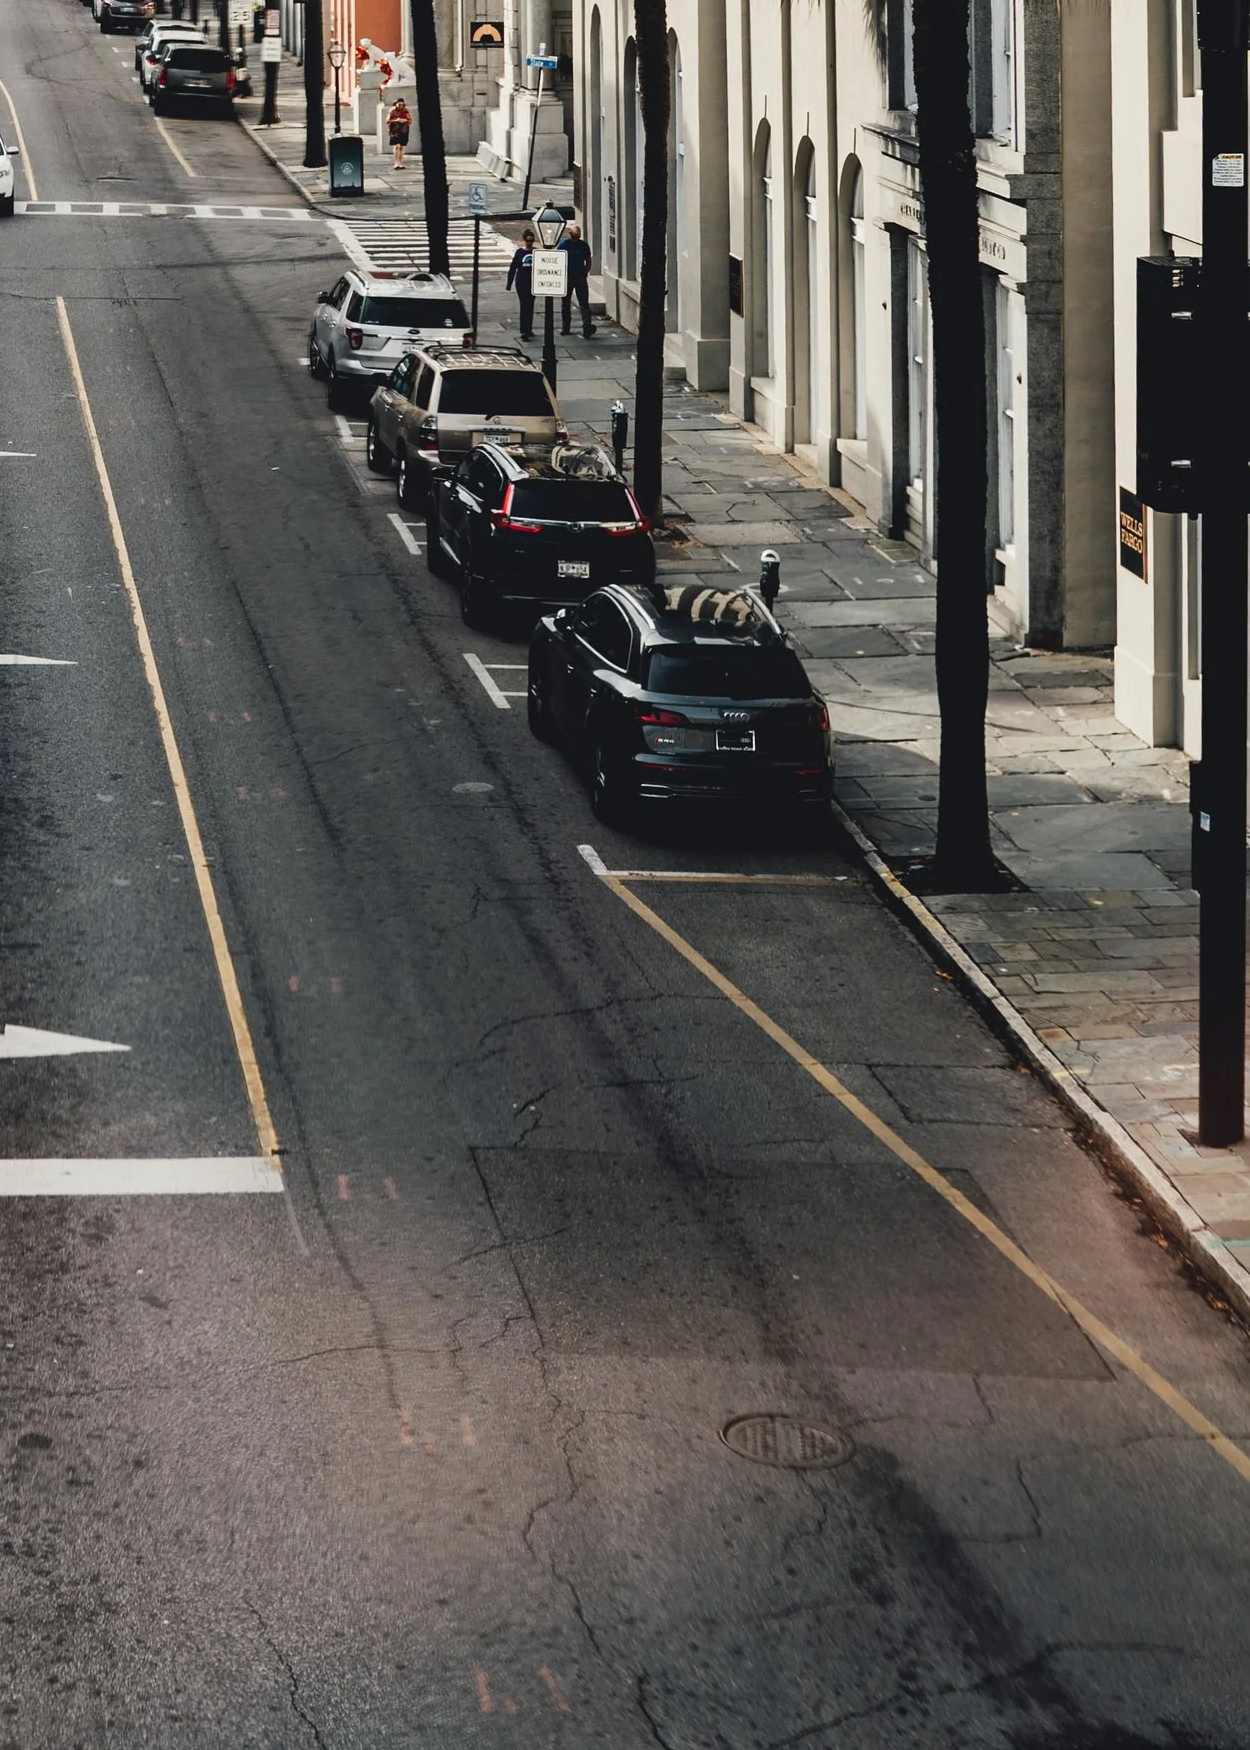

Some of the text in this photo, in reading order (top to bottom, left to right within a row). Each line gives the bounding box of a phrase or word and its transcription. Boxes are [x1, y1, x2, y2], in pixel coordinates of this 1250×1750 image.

[233, 11, 250, 21] 25
[1120, 511, 1143, 538] WELLS
[1121, 528, 1143, 554] FARGO
